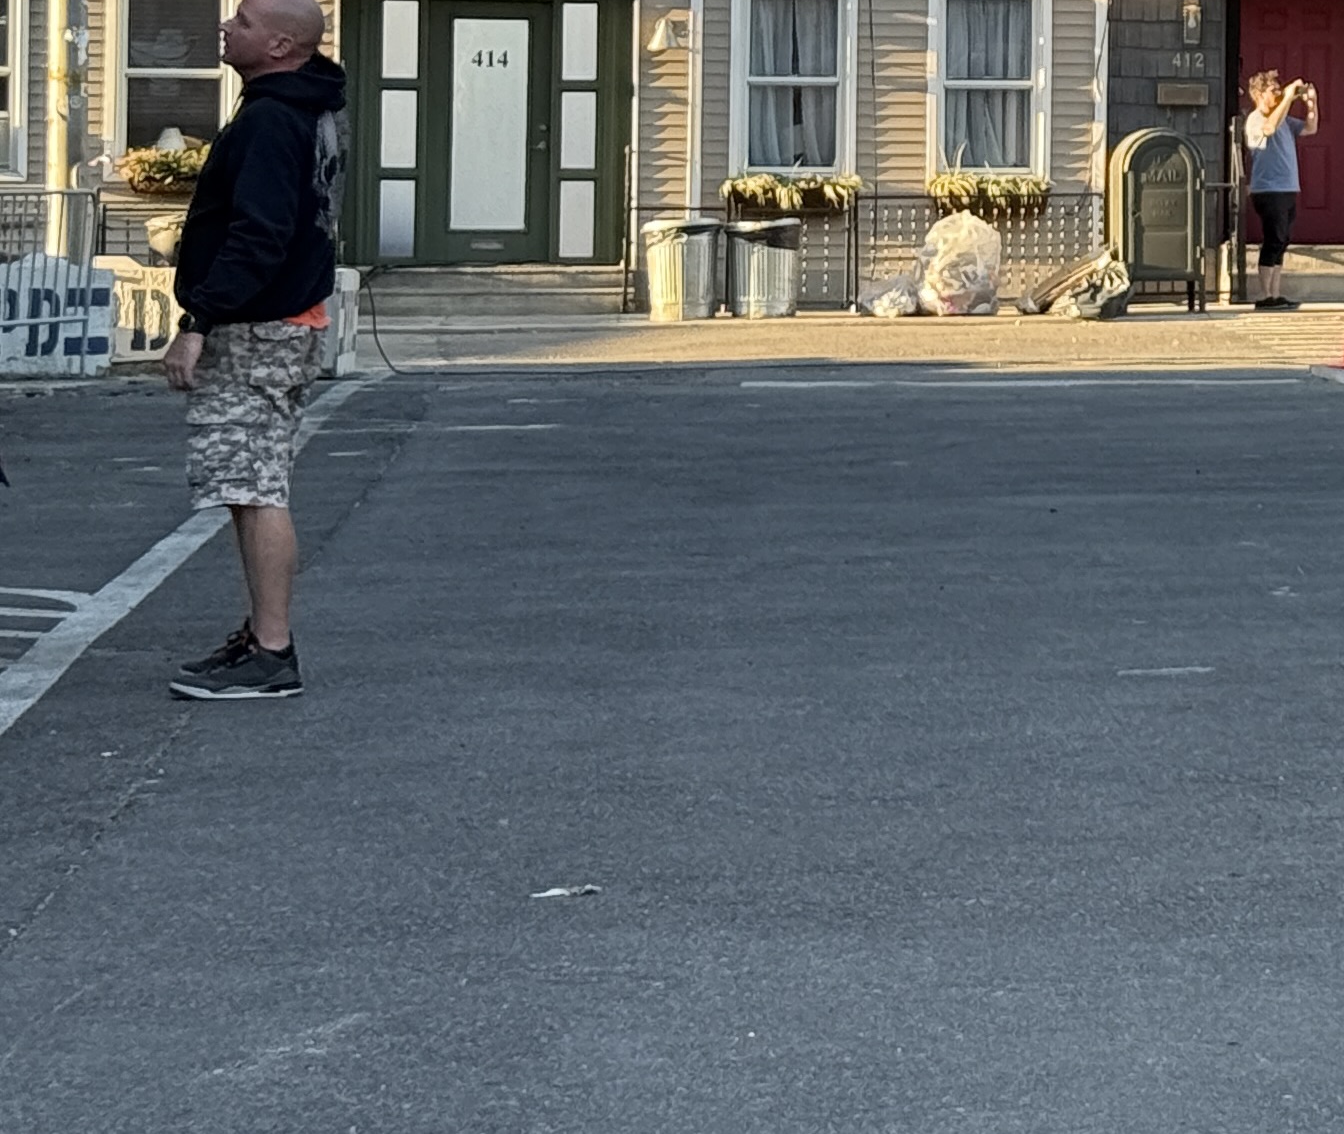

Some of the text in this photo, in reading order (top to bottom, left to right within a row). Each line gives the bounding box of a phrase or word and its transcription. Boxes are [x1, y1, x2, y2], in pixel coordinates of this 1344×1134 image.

[471, 49, 508, 68] 414
[1172, 52, 1204, 68] 412
[1146, 169, 1182, 183] MAIL
